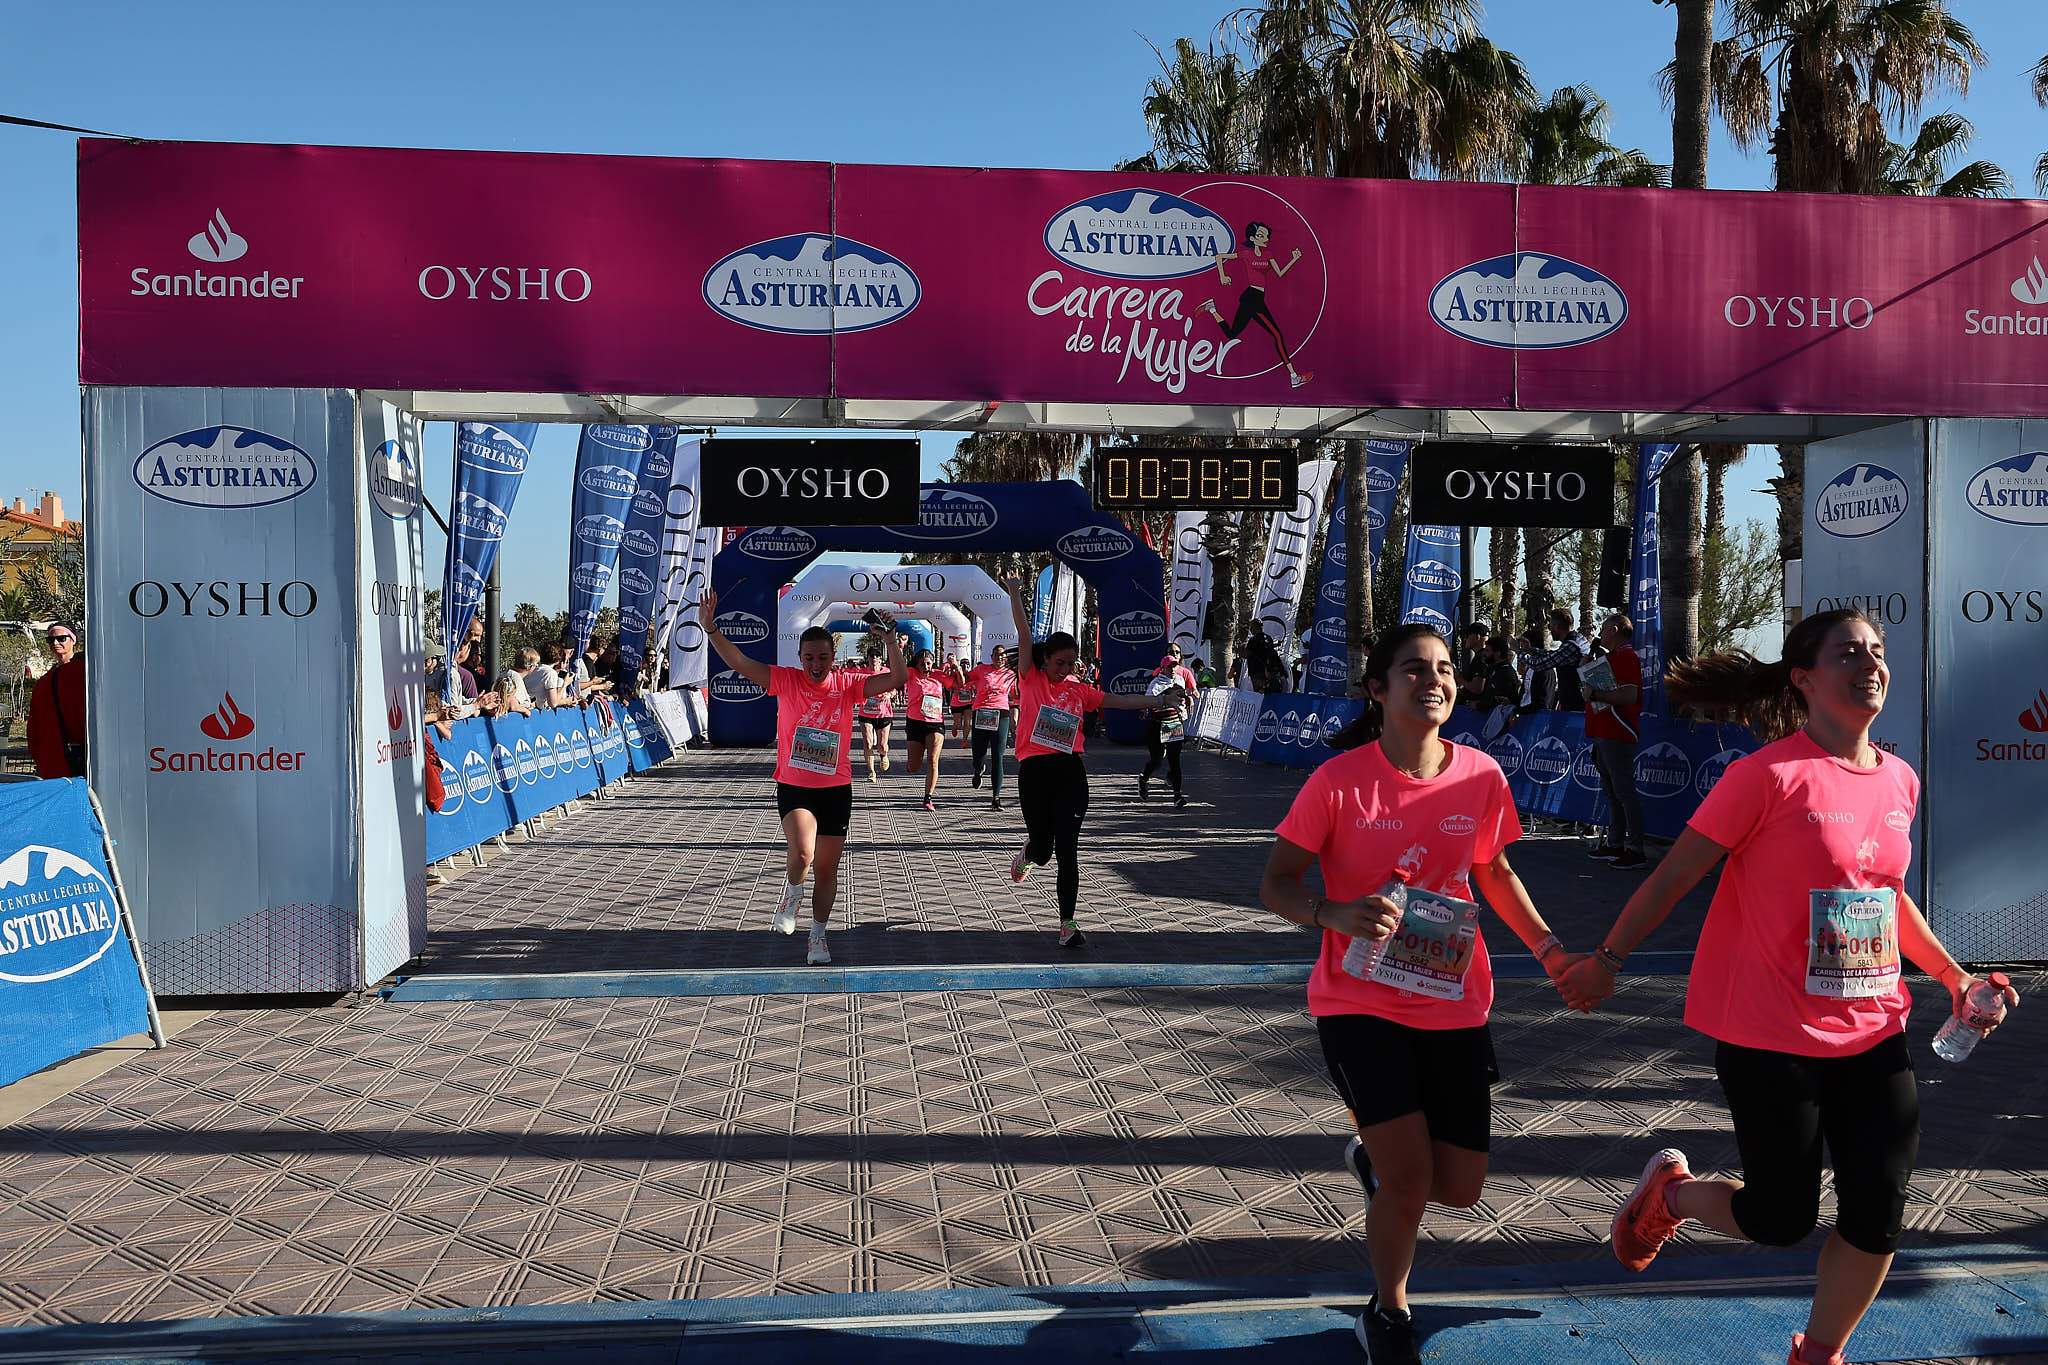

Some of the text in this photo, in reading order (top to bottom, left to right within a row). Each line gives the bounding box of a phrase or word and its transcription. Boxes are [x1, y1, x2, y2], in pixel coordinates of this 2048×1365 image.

[1059, 219, 1218, 257] ASTURIANA
[1089, 218, 1214, 231] CENTRAL LECHERA
[131, 267, 303, 298] Santander
[418, 265, 592, 302] OYSHO
[754, 267, 821, 277] CENTRAL
[720, 269, 904, 307] ASTURIANA
[1027, 270, 1184, 321] Carrera
[1475, 285, 1606, 296] CENTRAL LECHERA
[1444, 286, 1613, 324] ASTURIANA
[1723, 295, 1874, 330] OYSHO
[1065, 319, 1122, 353] de la
[1117, 317, 1242, 394] Mujer
[148, 456, 303, 487] ASTURIANA
[175, 455, 297, 463] CENTRAL LECHERA
[737, 467, 890, 499] OYSHO
[1109, 458, 1281, 499] 00:38:36
[1445, 469, 1586, 502] OYSHO
[1999, 477, 2044, 486] CENTRAL
[920, 512, 989, 527] URIANA
[1821, 494, 1901, 523] ASTURIANA
[744, 538, 810, 551] ASTURIANA
[1063, 540, 1128, 553] ASTURIANA
[850, 572, 946, 593] OYSHO
[128, 581, 318, 617] OYSHO
[372, 580, 418, 619] OYSHO
[1962, 590, 2044, 624] OYS
[150, 747, 306, 772] Santander
[1527, 752, 1567, 774] ASTURIANA
[1633, 759, 1686, 786] ASTURIANA
[1356, 818, 1403, 830] OYSHO
[1808, 811, 1854, 823] OYSHO
[0, 891, 50, 912] CENTRAL
[1849, 937, 1882, 955] 016
[1857, 959, 1873, 967] 5843
